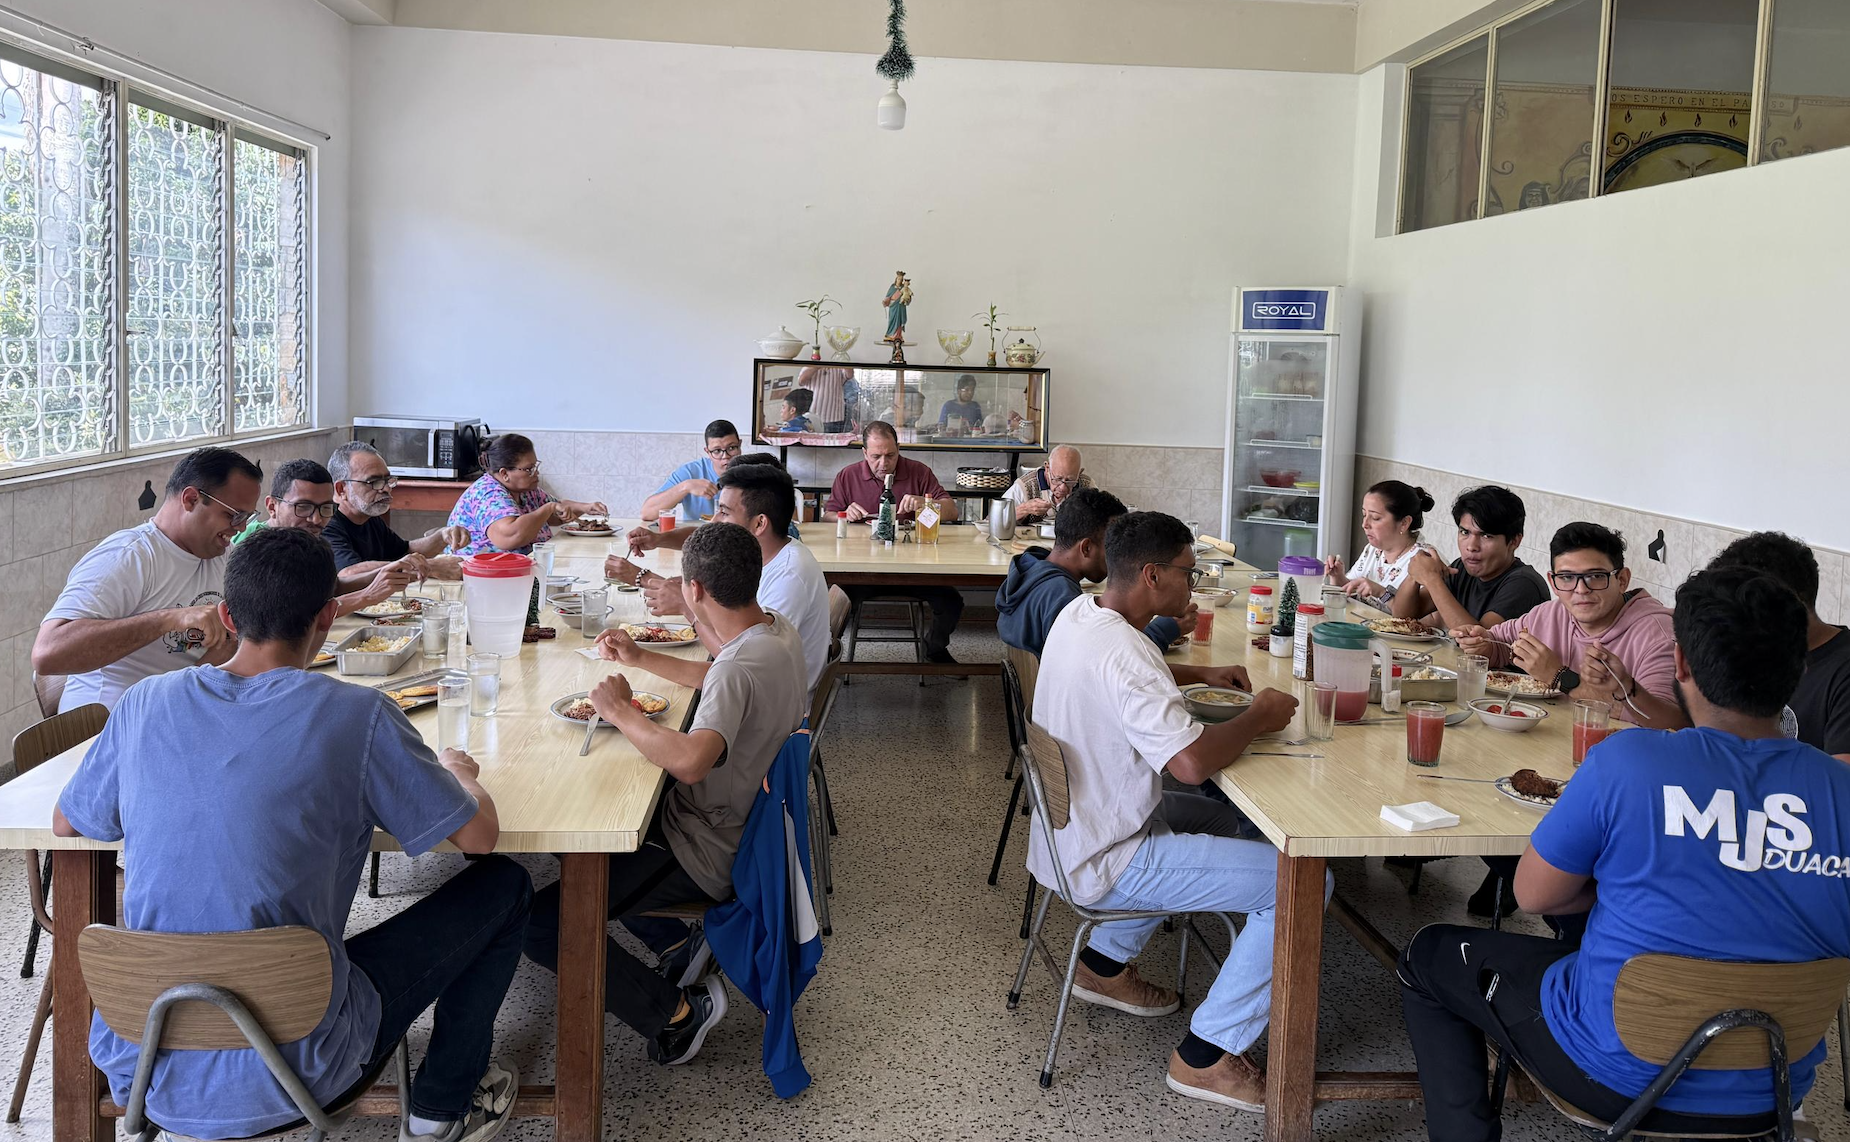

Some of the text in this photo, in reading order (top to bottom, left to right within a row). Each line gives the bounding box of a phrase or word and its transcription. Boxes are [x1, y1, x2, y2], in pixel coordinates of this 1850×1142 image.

[1611, 93, 1627, 103] OS
[1633, 94, 1684, 105] ESPERO
[1691, 97, 1705, 106] EN
[1712, 98, 1726, 107] EL
[1257, 305, 1312, 316] ROYAL
[1663, 785, 1813, 872] MJS
